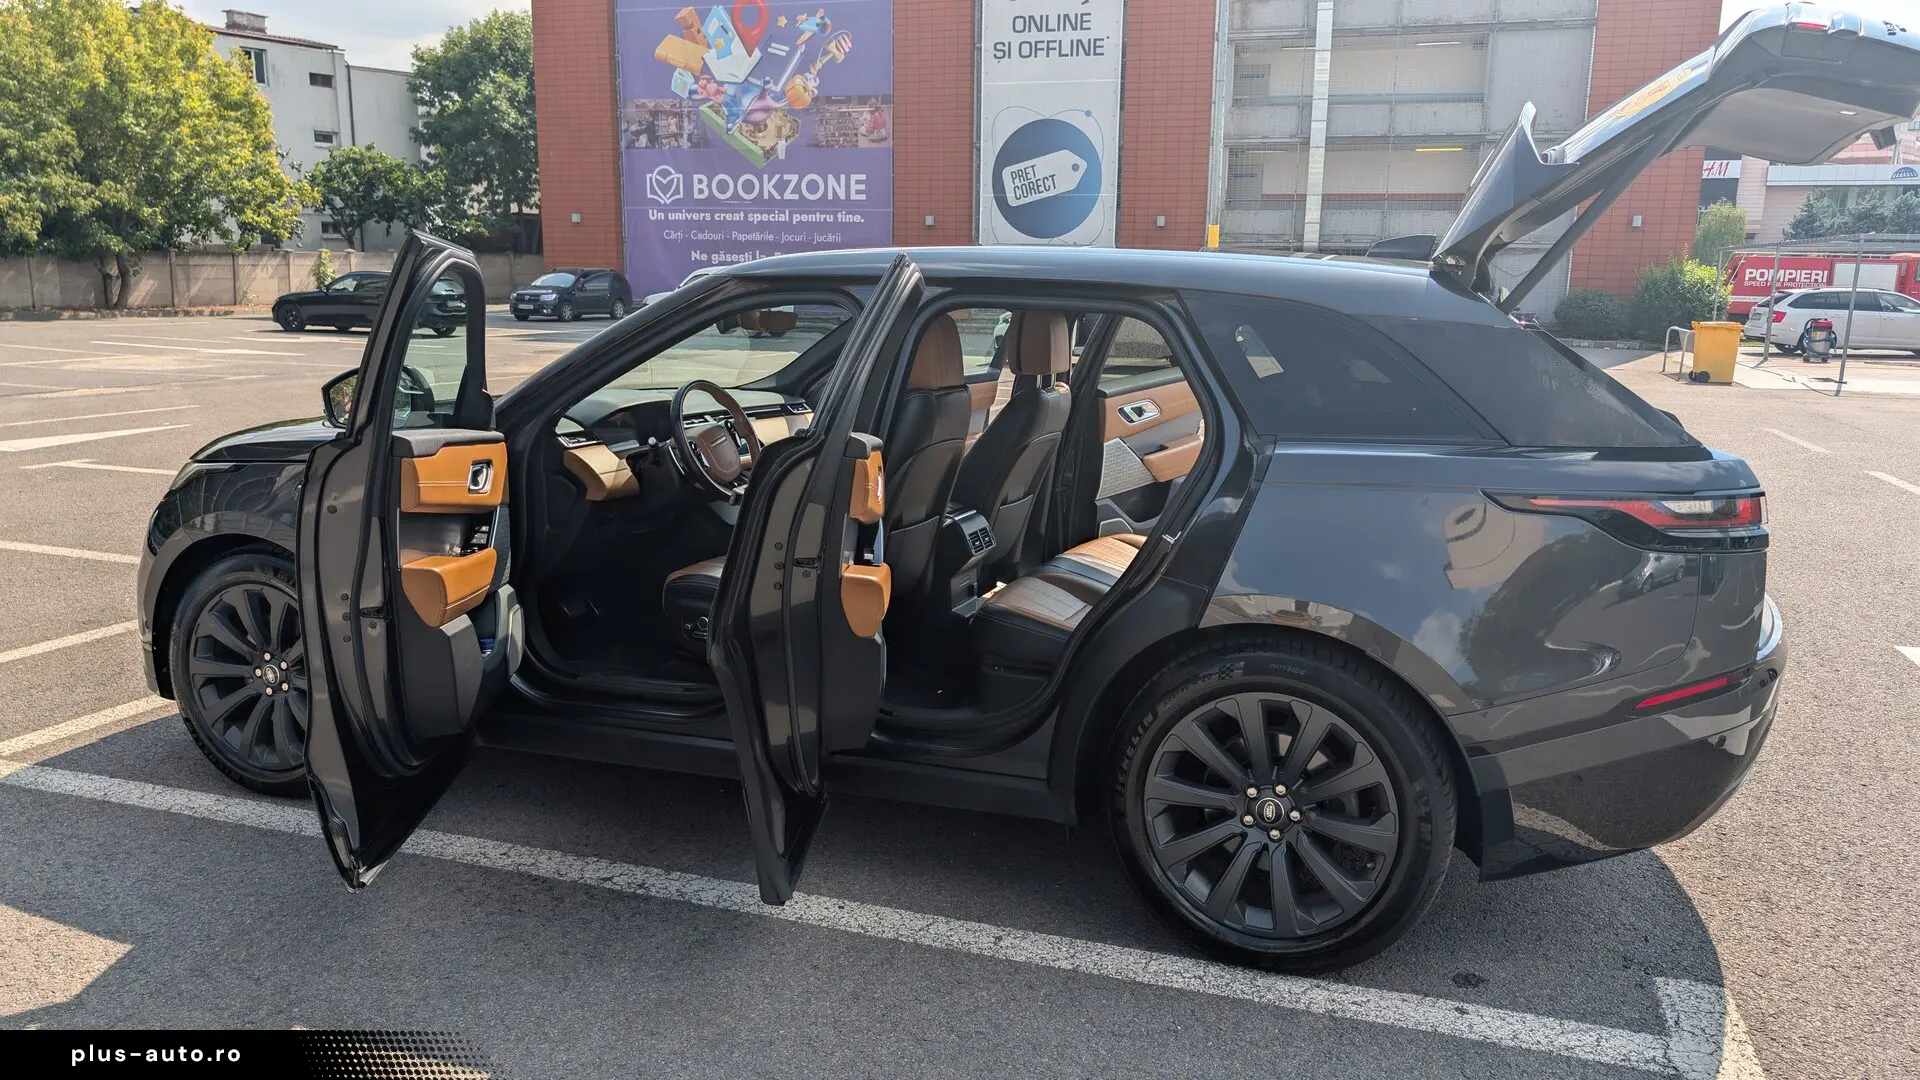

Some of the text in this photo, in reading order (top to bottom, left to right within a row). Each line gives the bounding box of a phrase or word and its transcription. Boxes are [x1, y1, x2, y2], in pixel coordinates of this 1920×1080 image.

[1012, 12, 1092, 34] ONLINE
[993, 41, 1012, 63] ȘI
[1010, 164, 1037, 185] PRET
[1703, 161, 1730, 177] H&M
[693, 173, 867, 200] BOOKZONE
[1013, 173, 1057, 201] CORECT
[649, 209, 865, 224] Un univers creat special pentru tine.
[691, 229, 724, 240] Cadouri
[780, 232, 806, 243] Jocuri
[691, 250, 708, 261] Ne
[1744, 268, 1828, 282] POMPIERI
[1115, 711, 1154, 800] ICHELIN
